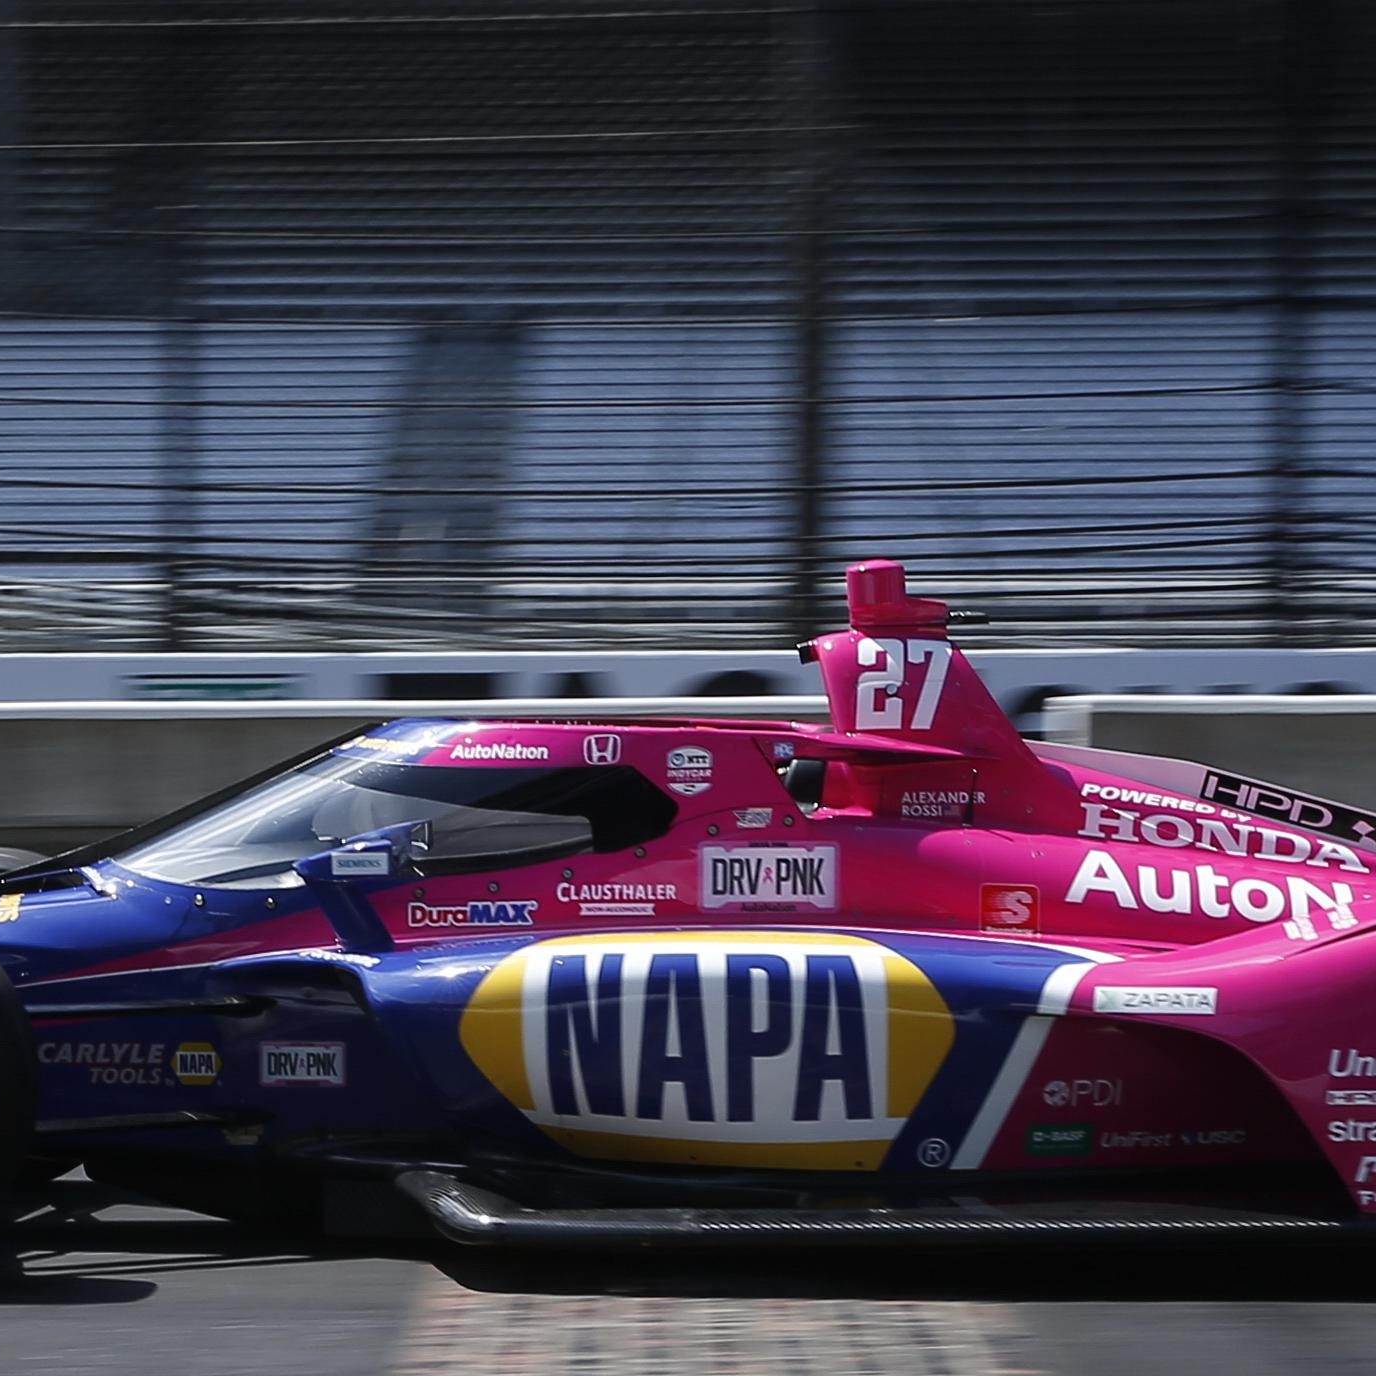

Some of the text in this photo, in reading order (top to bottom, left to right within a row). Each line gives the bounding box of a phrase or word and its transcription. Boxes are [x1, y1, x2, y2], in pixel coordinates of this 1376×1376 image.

[855, 637, 953, 730] 27
[450, 743, 549, 760] AutoNation
[686, 754, 709, 764] NTT
[667, 769, 713, 778] INDYCAR
[901, 791, 987, 804] ALEXANDER
[1081, 783, 1216, 814] POWERED
[1204, 775, 1334, 828] HPD
[901, 805, 943, 817] ROSSI
[1077, 802, 1371, 874] HONDA
[336, 859, 382, 868] SIEMENS
[712, 858, 826, 895] DRV PNK
[557, 882, 677, 901] CLAUSTHALER
[1122, 992, 1212, 1009] ZAPATA
[546, 953, 874, 1122] NAPA
[37, 1043, 165, 1063] CARLYLE
[179, 1054, 216, 1074] NAPA
[267, 1052, 337, 1076] DRV PNK
[89, 1068, 162, 1084] TOOLS
[1072, 1079, 1123, 1106] PDI
[1101, 1131, 1172, 1147] UniFirst
